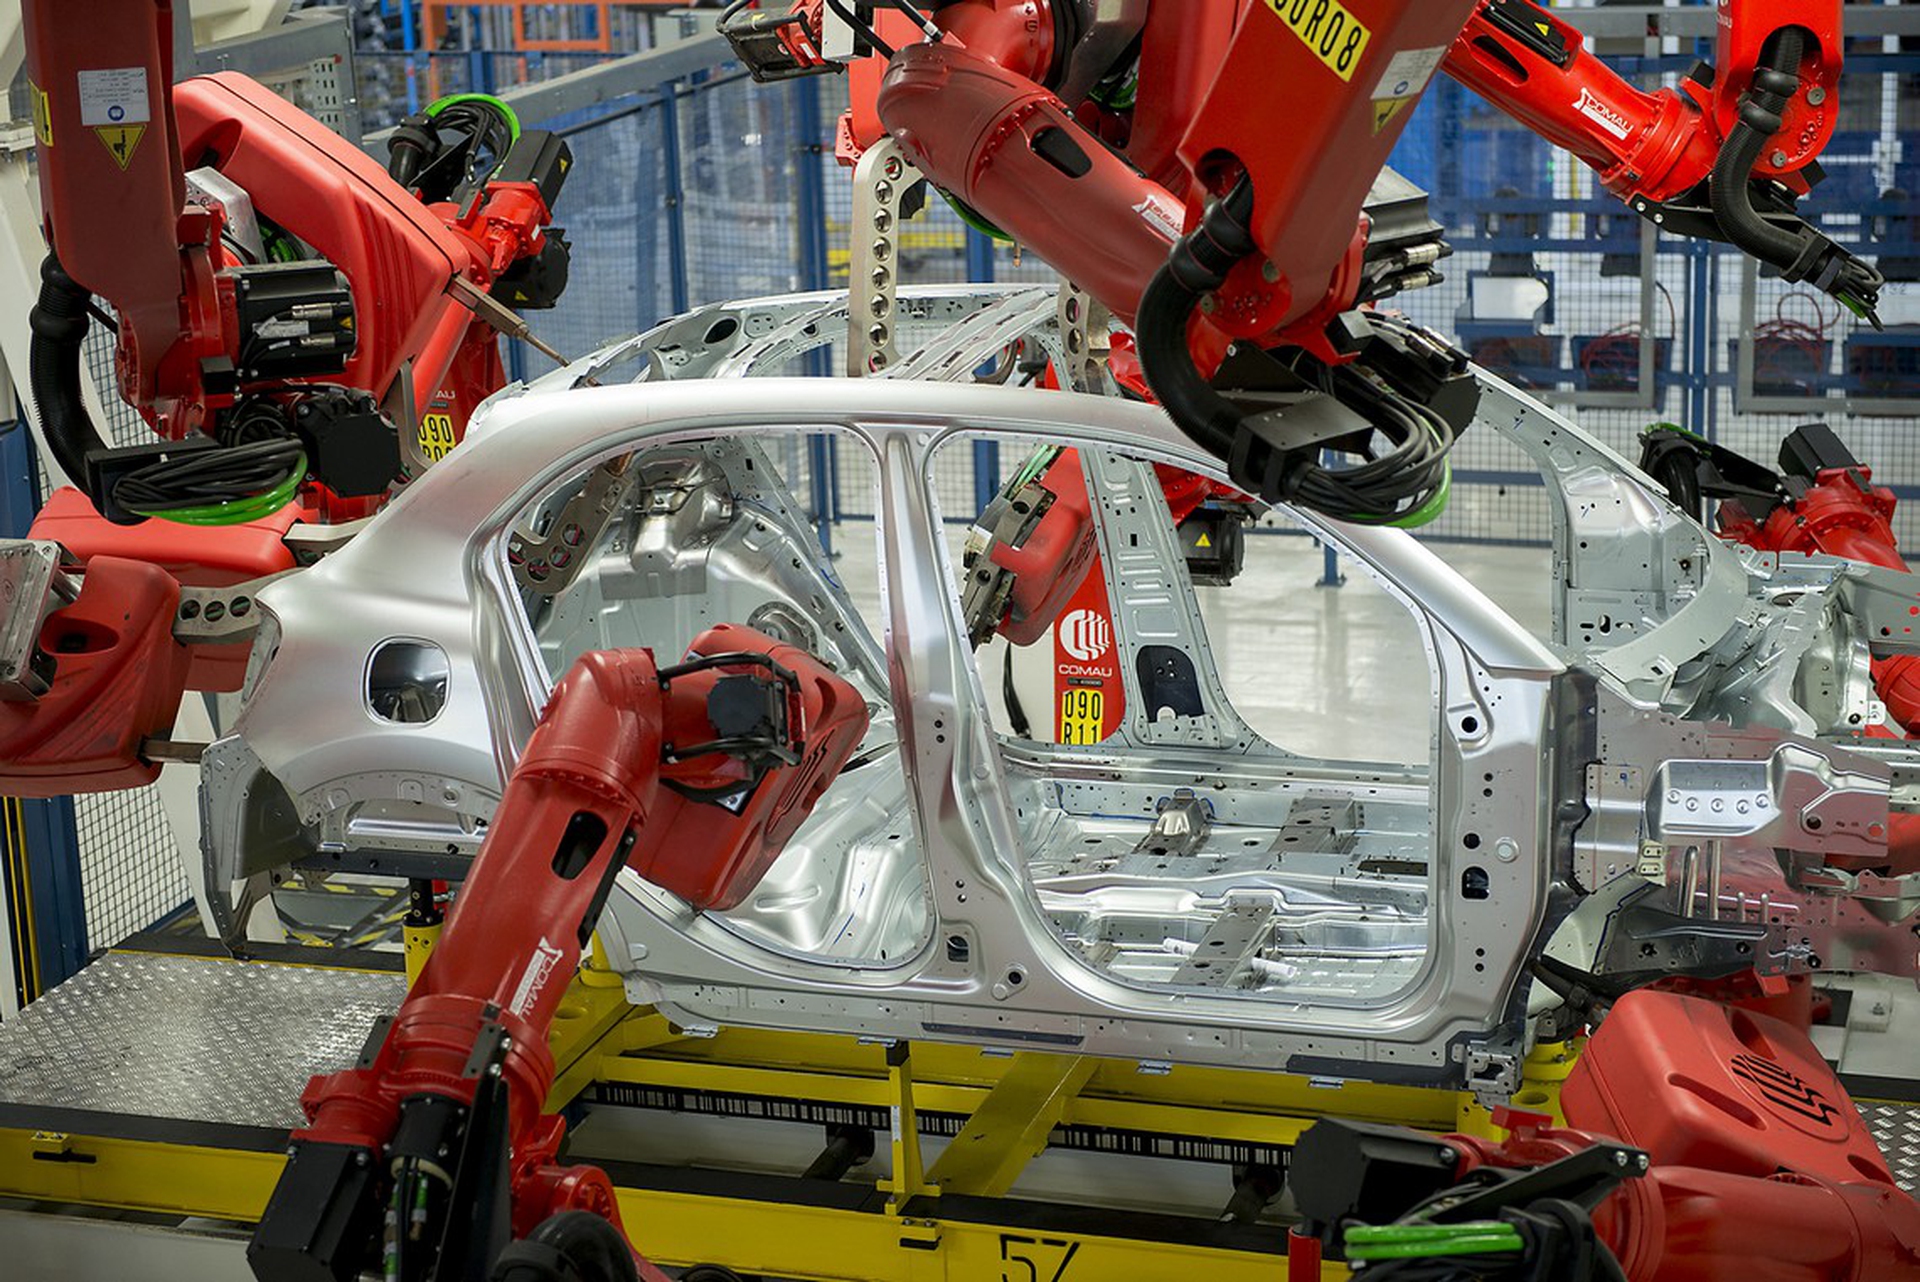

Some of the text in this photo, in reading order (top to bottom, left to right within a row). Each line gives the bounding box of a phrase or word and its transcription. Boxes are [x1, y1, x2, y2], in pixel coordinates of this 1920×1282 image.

[1274, 0, 1362, 72] 0R08
[1586, 98, 1634, 134] COMAU
[1058, 664, 1112, 677] COMAU
[1064, 691, 1101, 721] 090
[1063, 722, 1098, 744] R11
[519, 956, 555, 1025] COMAU
[1000, 1233, 1080, 1282] 57
